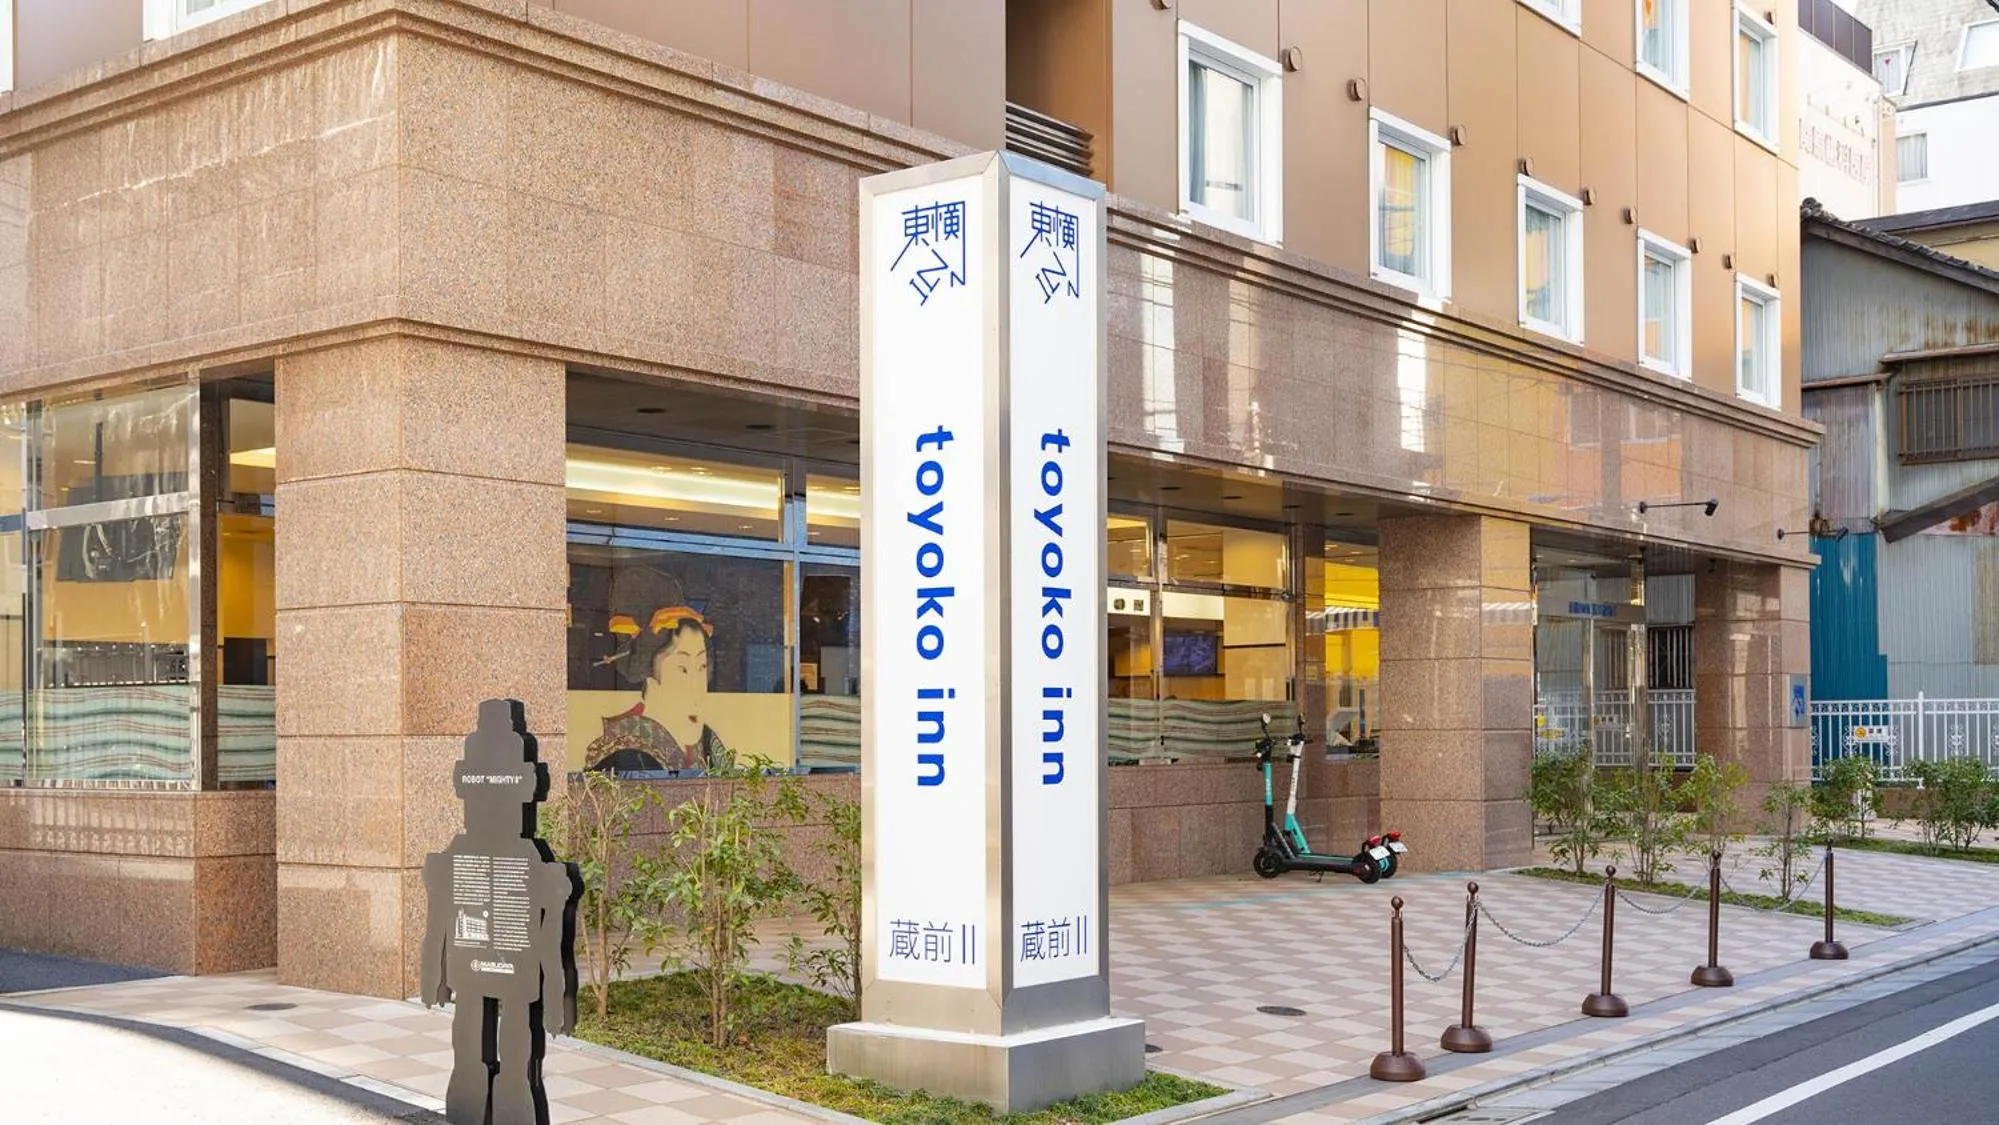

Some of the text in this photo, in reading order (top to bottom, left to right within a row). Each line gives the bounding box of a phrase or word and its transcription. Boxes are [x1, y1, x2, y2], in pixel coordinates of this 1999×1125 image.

[462, 775, 485, 784] ROBOT
[907, 424, 956, 787] toyoko inn
[1034, 428, 1073, 785] toyoko inn
